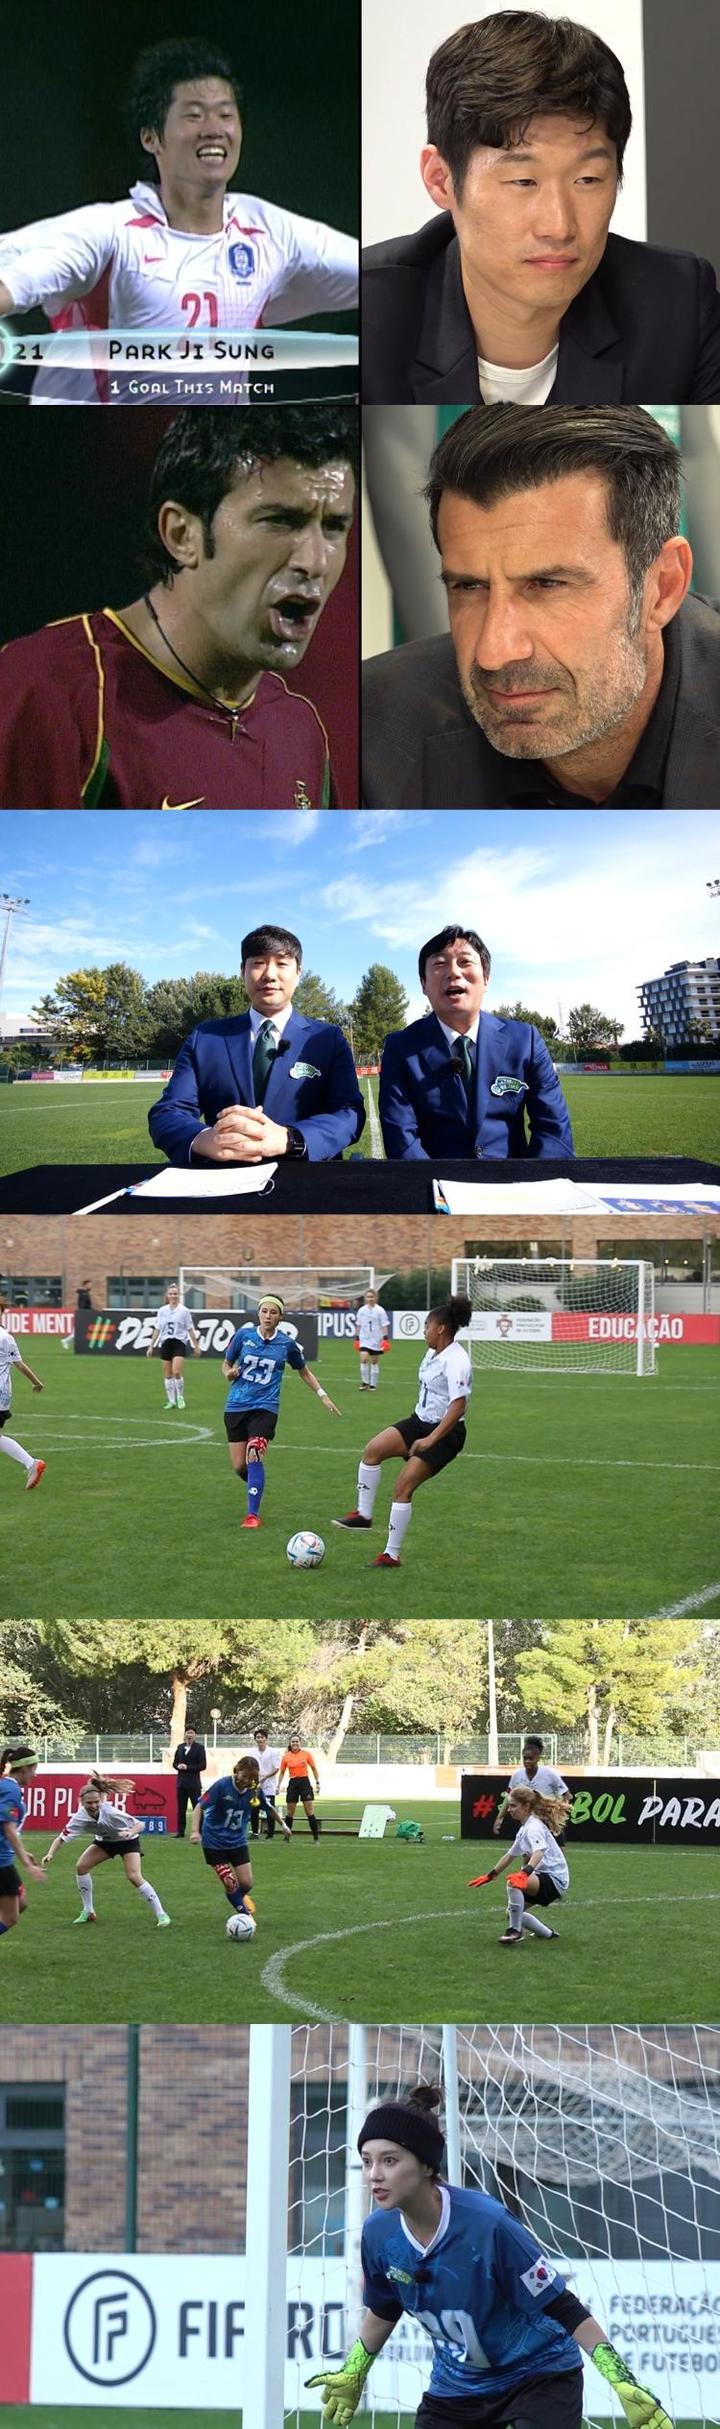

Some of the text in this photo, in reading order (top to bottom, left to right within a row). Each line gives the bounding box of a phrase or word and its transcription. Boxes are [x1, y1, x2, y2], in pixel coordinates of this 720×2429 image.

[181, 292, 219, 345] 21
[167, 1321, 175, 1335] 5
[242, 1355, 276, 1386] 23
[224, 1808, 245, 1831] 13
[637, 1796, 720, 1829] PARA
[148, 1820, 164, 1832] 8 9
[609, 2322, 720, 2344] PORTUGUE
[640, 2352, 720, 2373] FUTEBO
